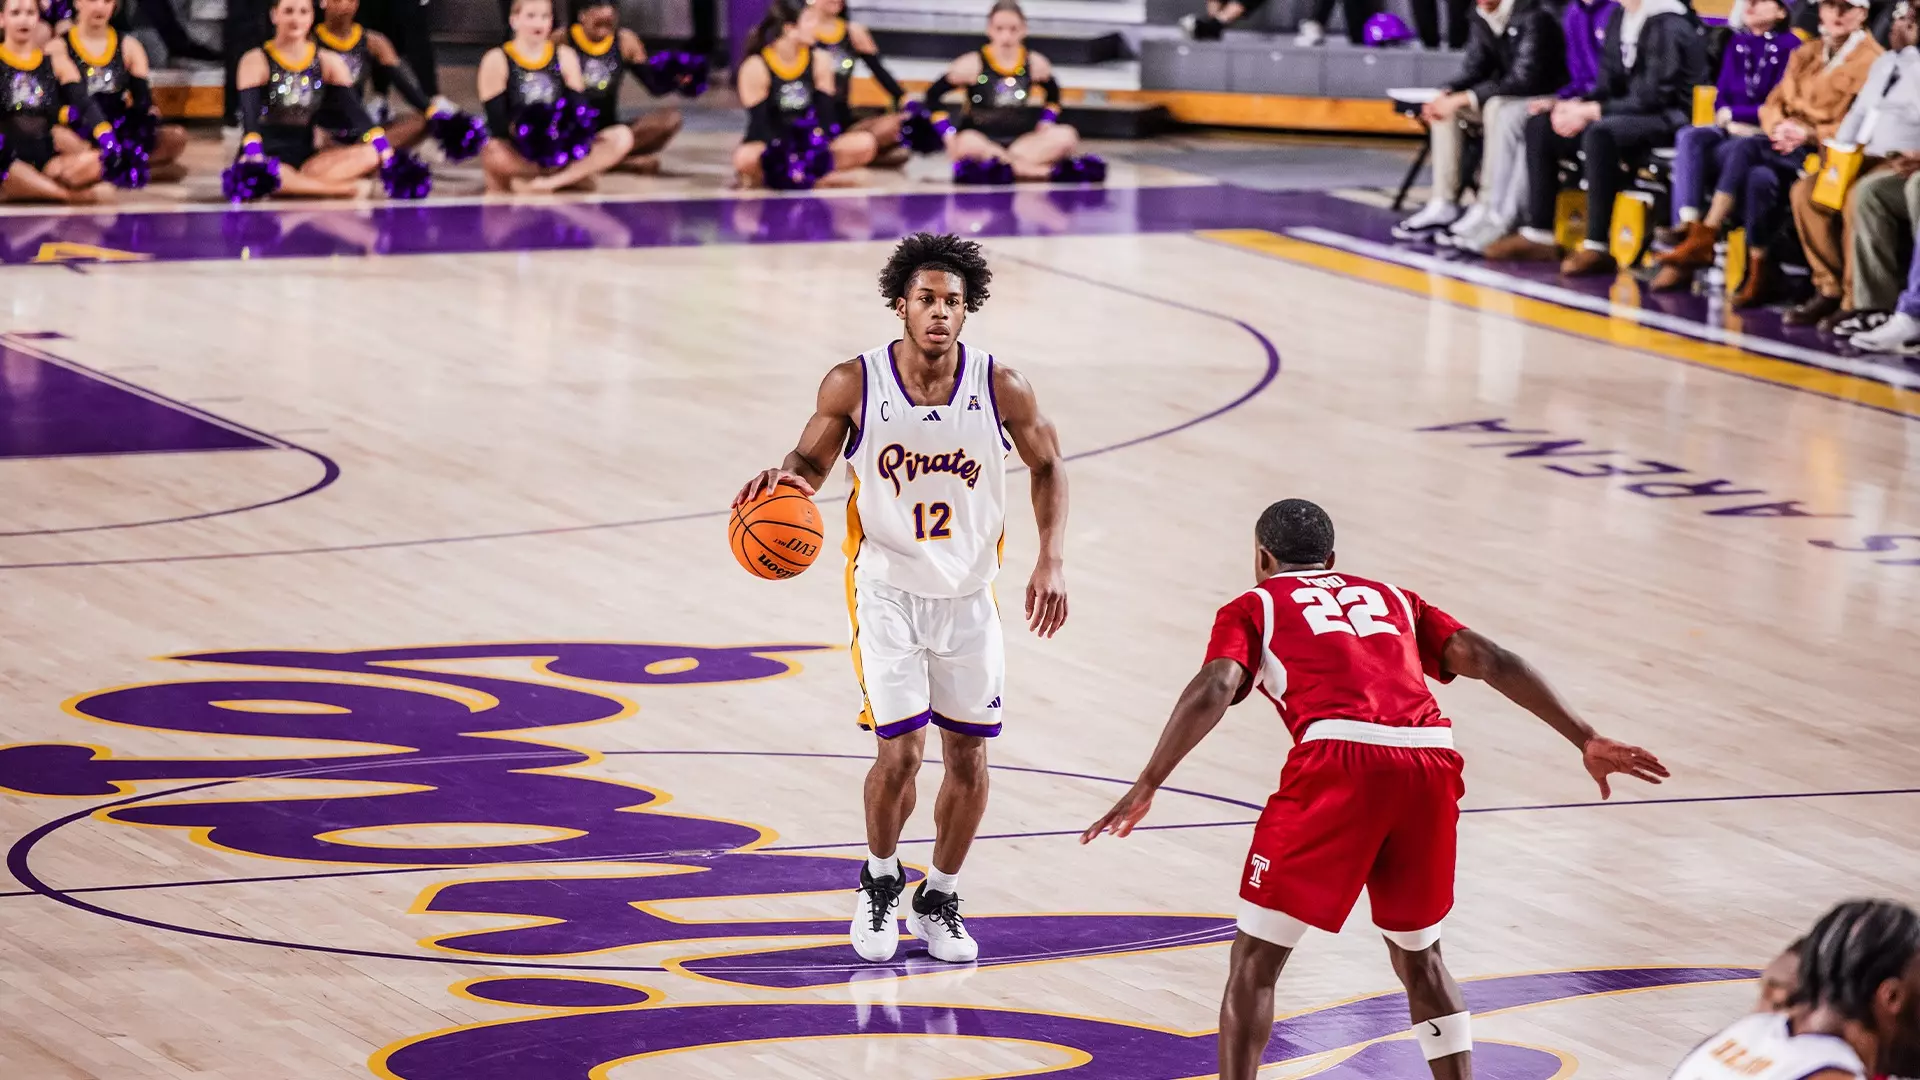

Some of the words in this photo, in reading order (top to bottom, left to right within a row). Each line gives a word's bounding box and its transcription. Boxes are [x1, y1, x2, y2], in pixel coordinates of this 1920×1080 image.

[880, 400, 890, 422] C
[877, 442, 982, 498] Pirates
[1413, 418, 1856, 518] ARENA
[912, 501, 952, 542] 12
[1290, 585, 1401, 638] 22
